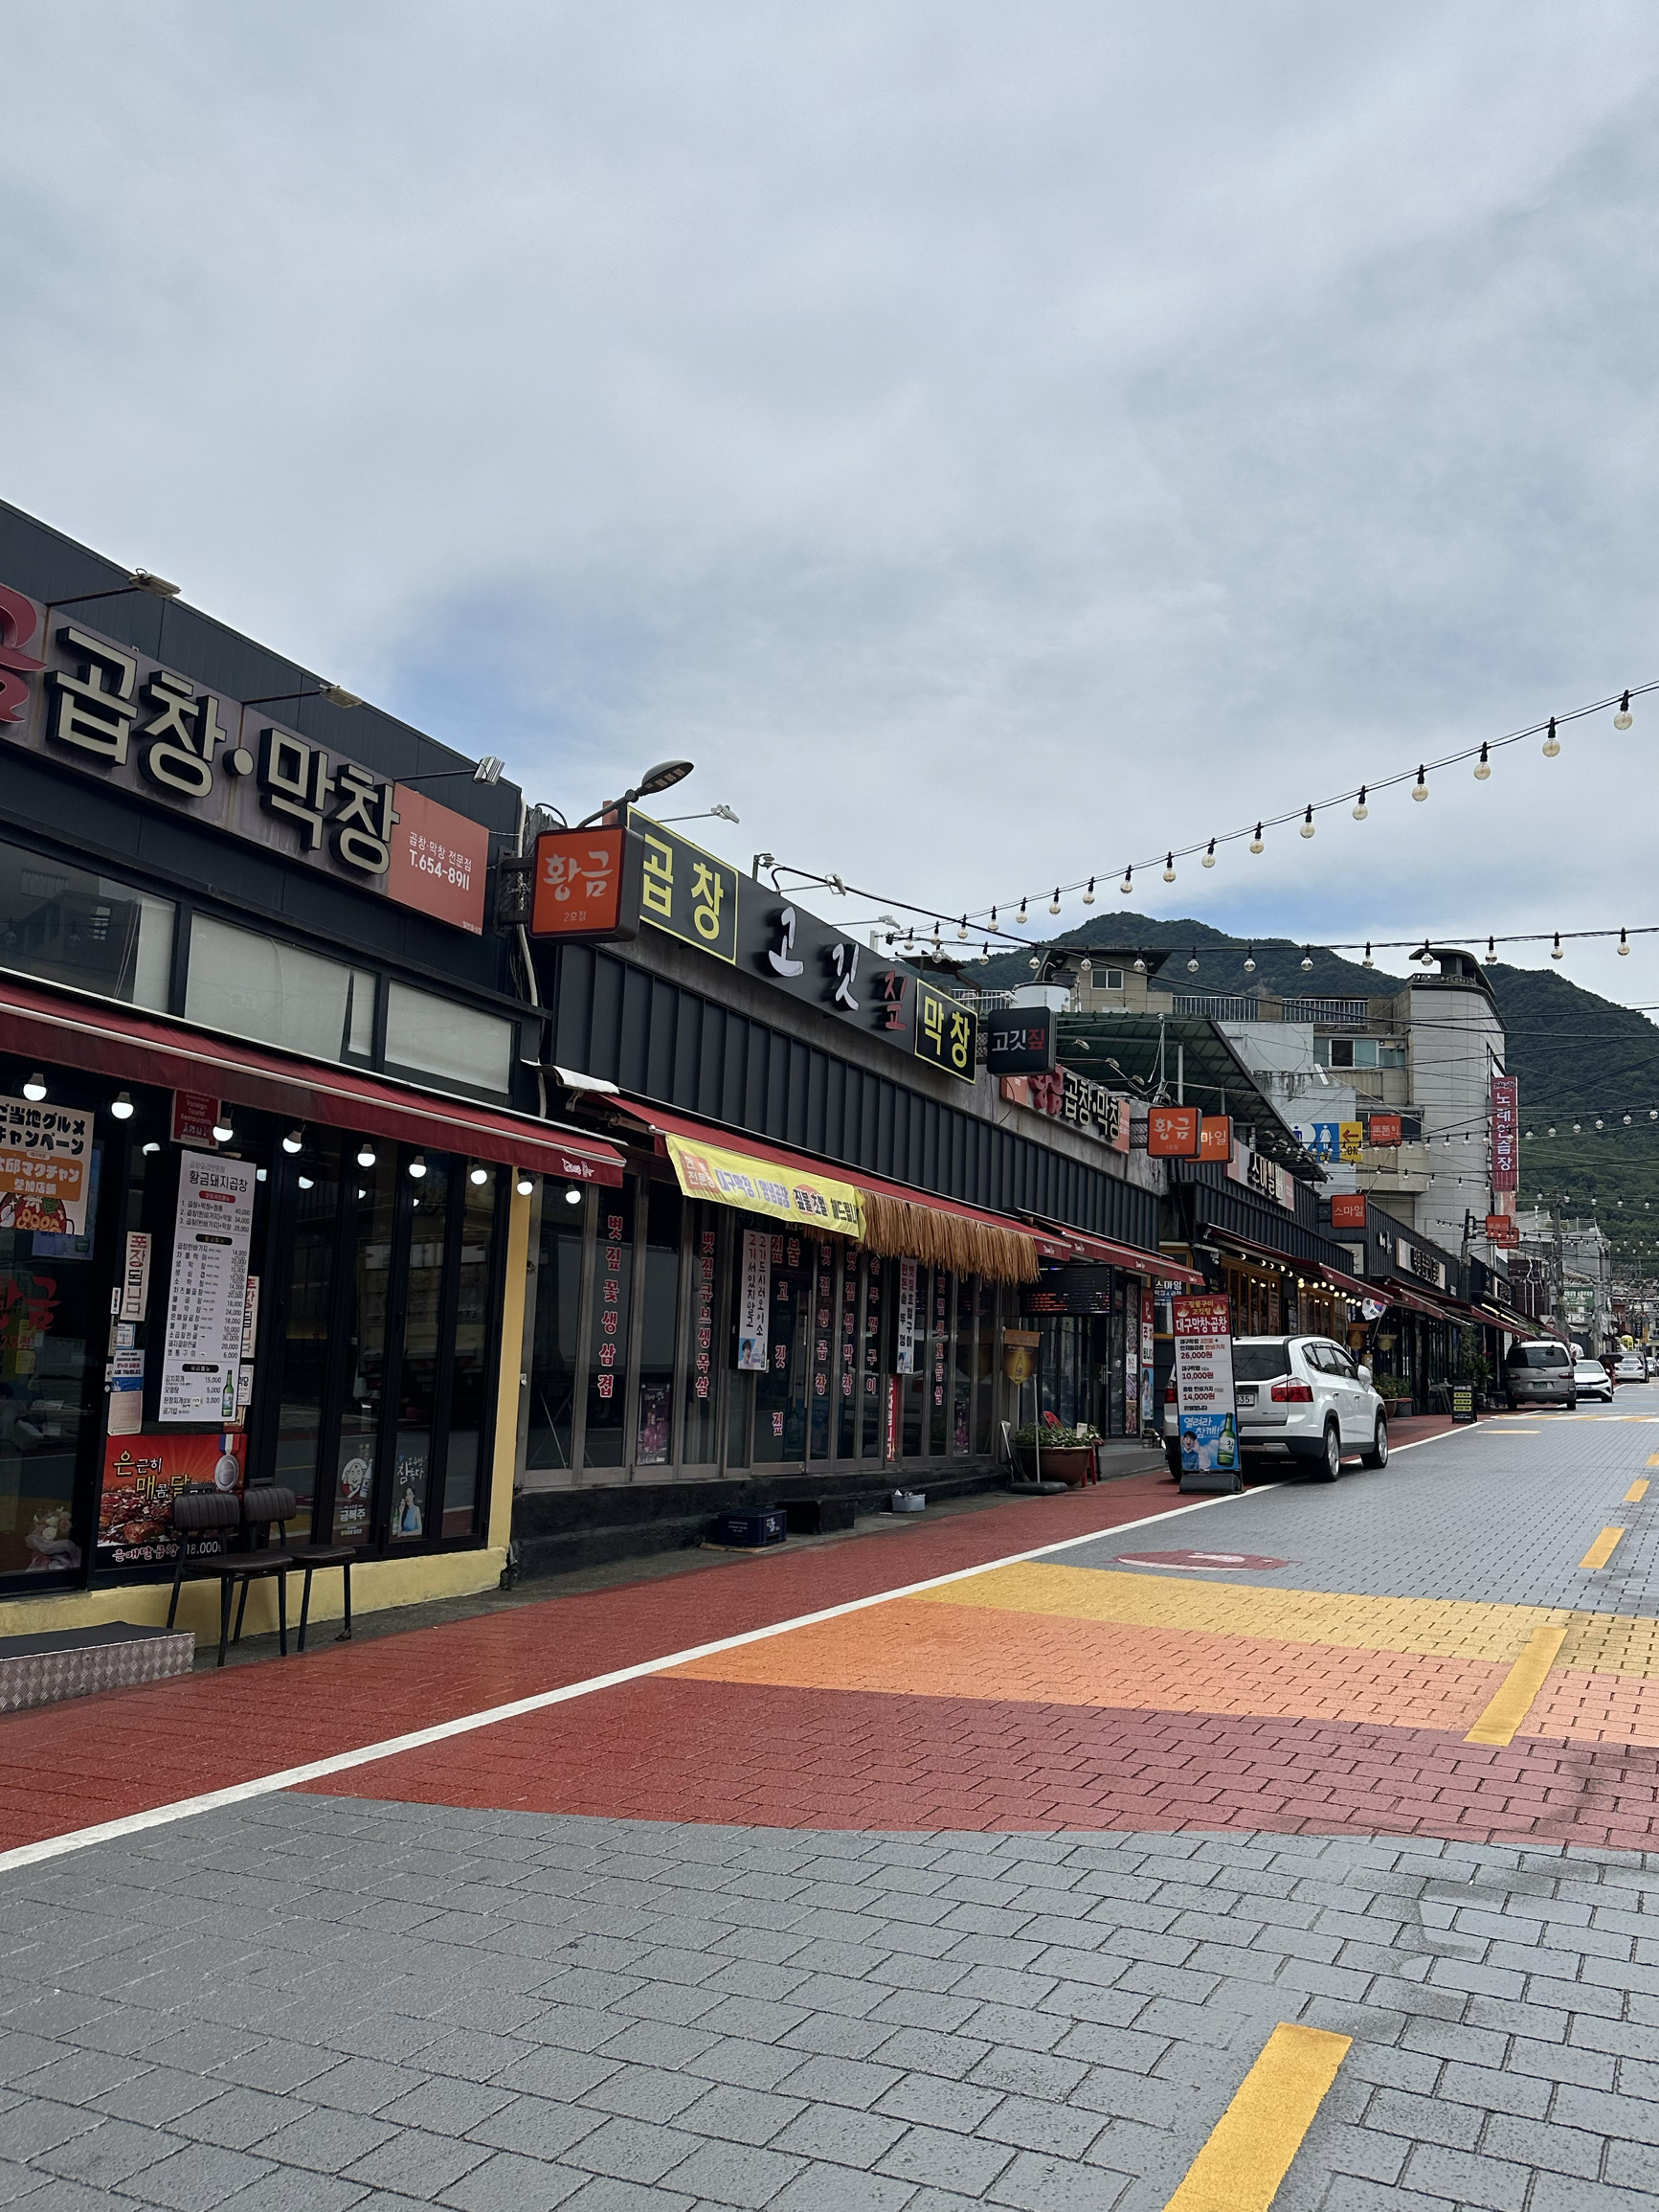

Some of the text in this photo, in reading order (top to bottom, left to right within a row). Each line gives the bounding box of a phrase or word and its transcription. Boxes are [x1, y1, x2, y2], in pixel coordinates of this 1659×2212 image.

[409, 848, 470, 891] T.654-8911
[448, 849, 472, 872] 전문점
[543, 850, 614, 902] 황금
[643, 833, 724, 940] 곱창
[563, 911, 587, 922] 2호점
[924, 995, 970, 1068] 막창
[186, 1099, 208, 1110] Foreign
[1154, 1117, 1192, 1141] 황금
[1200, 1130, 1227, 1147] 마일
[1496, 1093, 1513, 1172] 노래연습장
[190, 1170, 248, 1192] 황금돼지곱창
[1251, 1152, 1275, 1195] 스마일
[1334, 1206, 1364, 1217] 스마일
[1155, 1280, 1182, 1290] 스마일
[1180, 1351, 1213, 1360] 26,000원
[1181, 1371, 1214, 1380] 10,000원
[1184, 1416, 1213, 1429] 열려라
[113, 1450, 163, 1476] 은근히
